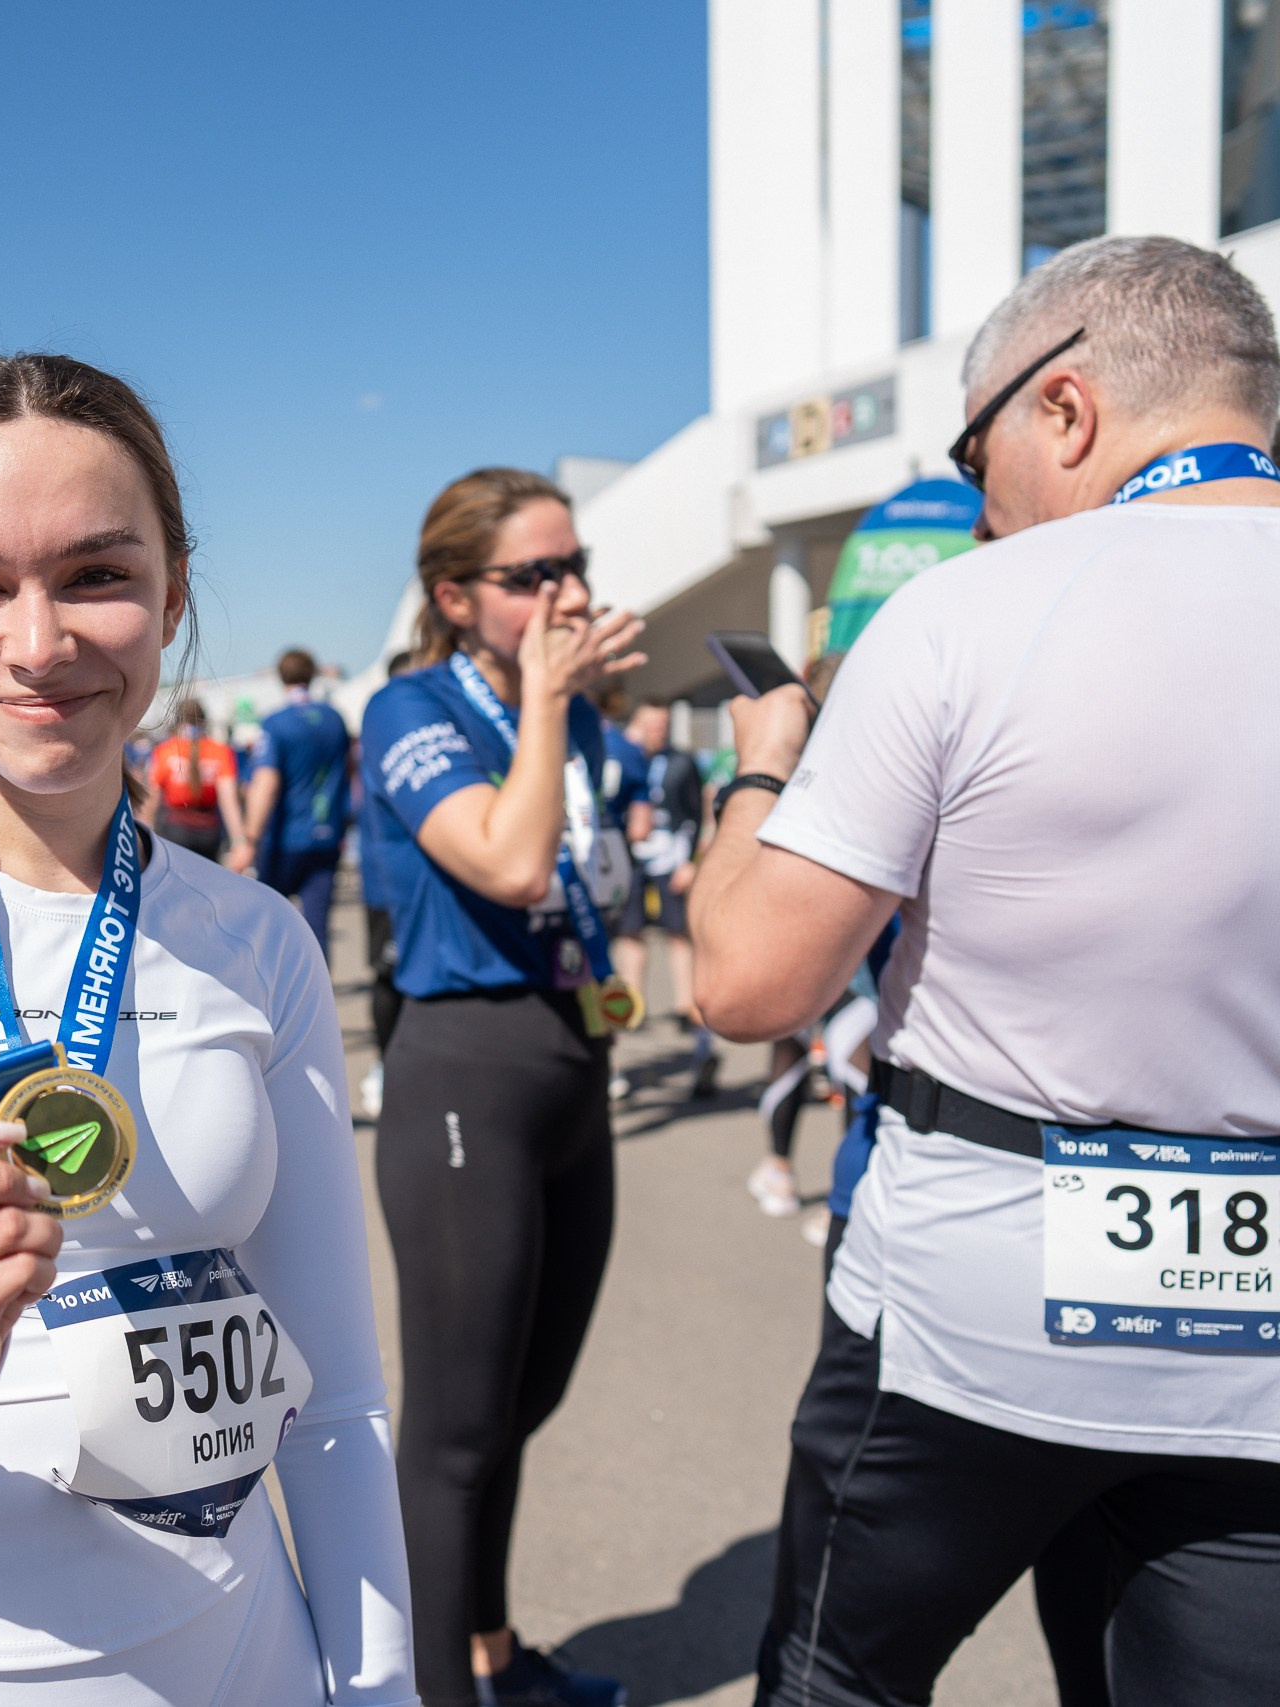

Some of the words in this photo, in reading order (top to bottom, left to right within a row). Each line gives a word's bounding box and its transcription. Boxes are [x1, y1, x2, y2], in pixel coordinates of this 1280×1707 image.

[1113, 456, 1201, 504] РОД
[1248, 452, 1276, 476] 10
[71, 891, 130, 1046] МЕНЯЮТ
[114, 811, 136, 894] ЭТОТ
[118, 1011, 178, 1021] IDE
[1058, 1140, 1078, 1155] 10
[1106, 1184, 1280, 1257] 318
[1160, 1267, 1272, 1292] СЕРГЕЙ
[56, 1294, 78, 1310] 10
[124, 1309, 286, 1423] 5502
[192, 1421, 255, 1464] ЮЛИЯ
